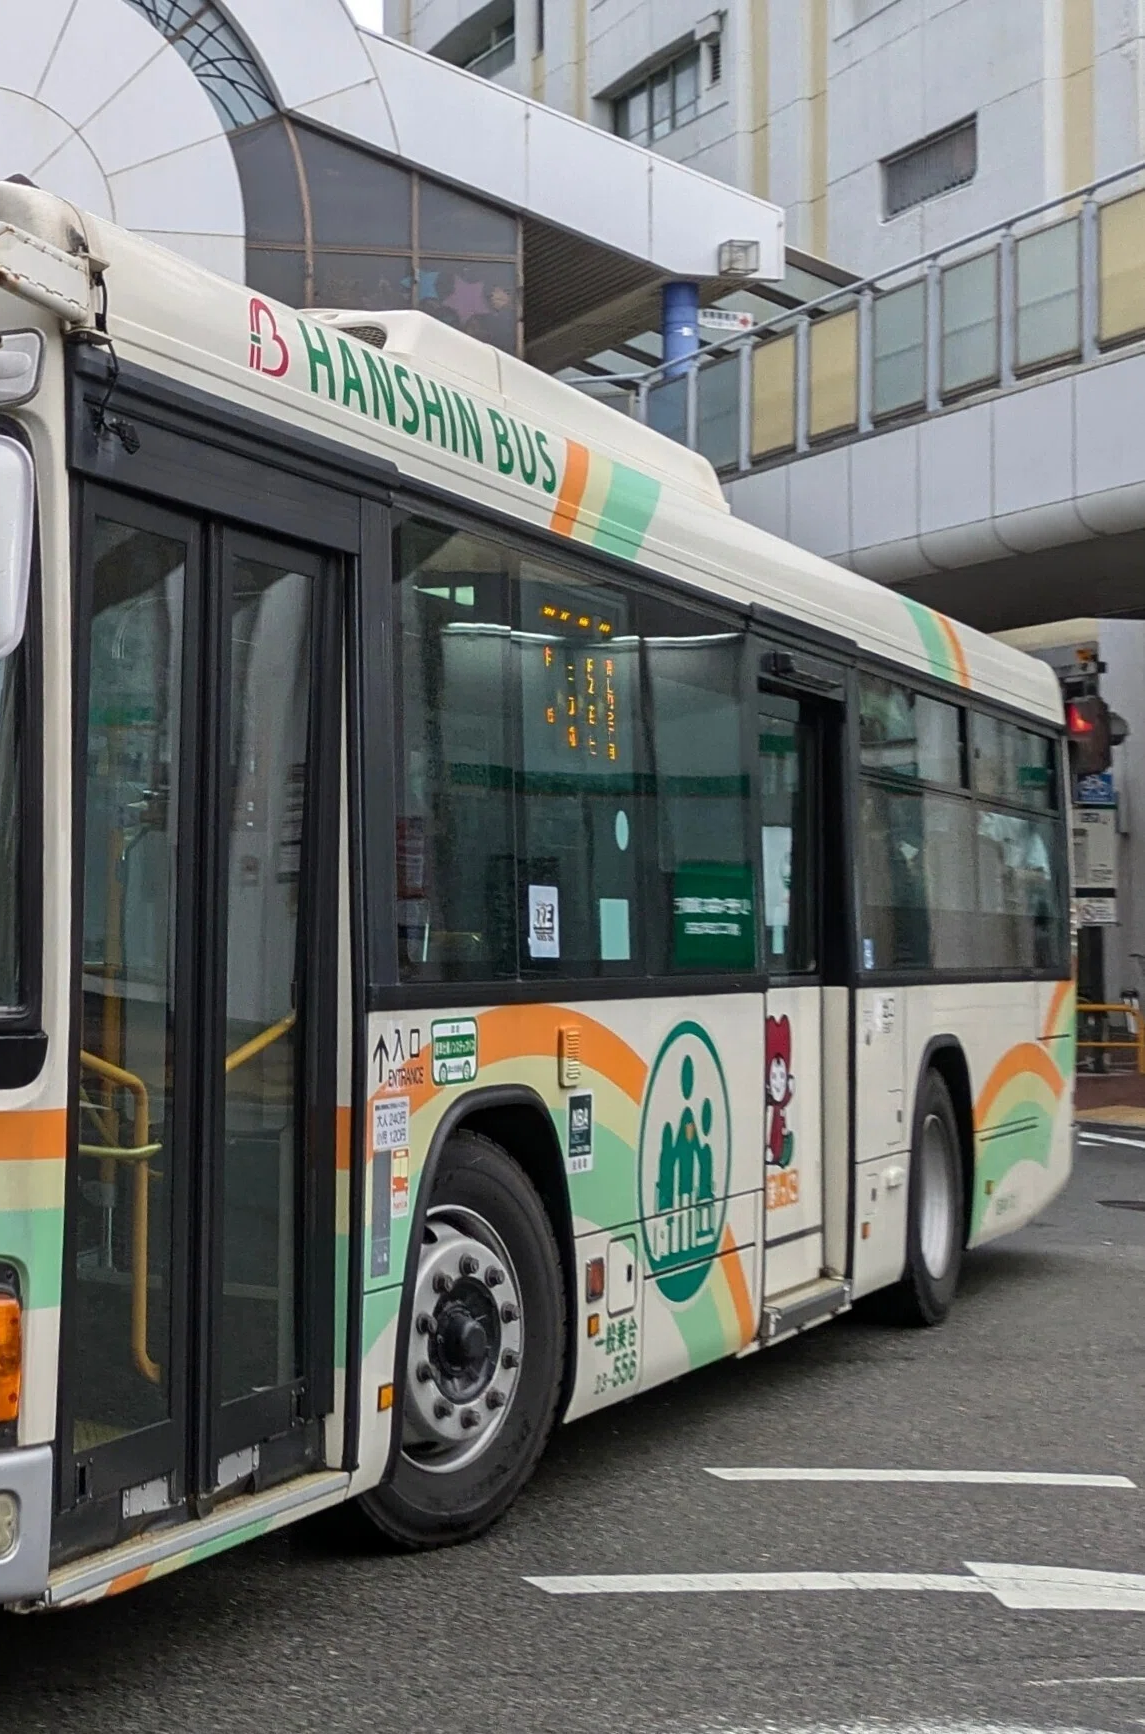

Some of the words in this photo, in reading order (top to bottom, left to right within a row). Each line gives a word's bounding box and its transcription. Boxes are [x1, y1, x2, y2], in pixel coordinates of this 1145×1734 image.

[297, 319, 484, 464] HANSHIN
[487, 408, 558, 494] BUS
[392, 1028, 421, 1062] 入口
[388, 1066, 424, 1088] ENTRANCE
